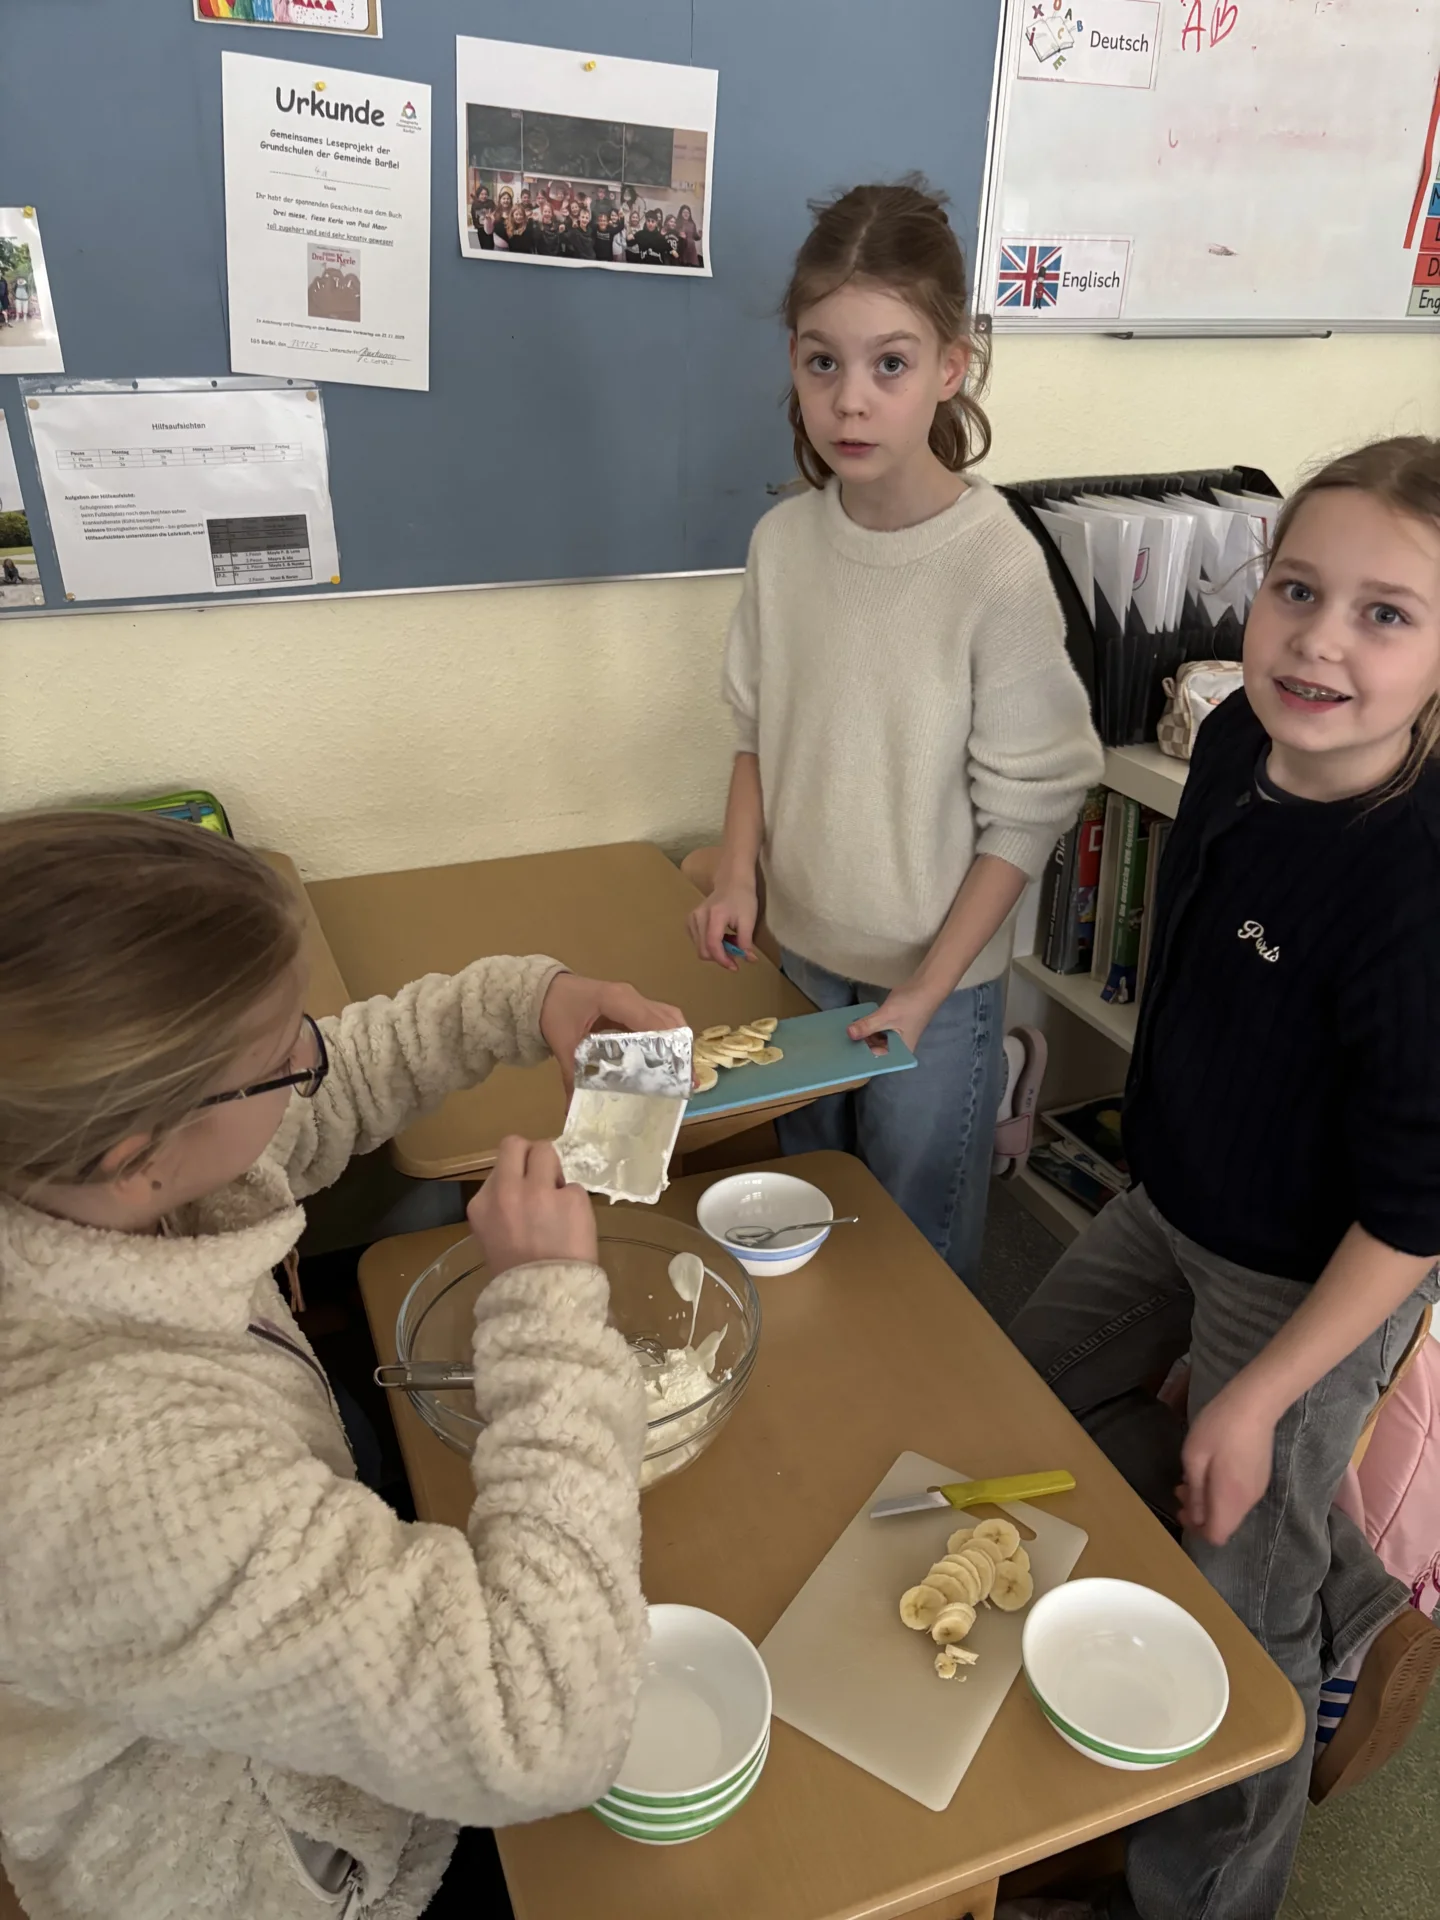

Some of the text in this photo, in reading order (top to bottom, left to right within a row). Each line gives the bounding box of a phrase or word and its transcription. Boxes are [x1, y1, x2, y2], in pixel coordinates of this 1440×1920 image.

[1064, 8, 1073, 20] A
[1076, 20, 1084, 32] B
[1090, 30, 1149, 52] Deutsch
[276, 86, 385, 127] Urkunde
[270, 129, 390, 155] Gemeinsames Leseprojekt der
[260, 141, 399, 170] Grundschulen der Gemeinde Barßel
[273, 208, 286, 217] Drei
[311, 214, 325, 222] fiese
[328, 216, 343, 225] Kerle
[358, 220, 370, 228] Paul
[295, 198, 328, 208] spannenden
[330, 203, 362, 214] Geschichte
[388, 211, 402, 219] Buch
[278, 224, 305, 234] zugehört
[319, 229, 331, 237] seid
[332, 231, 345, 239] sehr
[346, 233, 367, 242] kreativ
[1062, 271, 1120, 292] Englisch
[152, 422, 206, 431] Hilfsaufsichten
